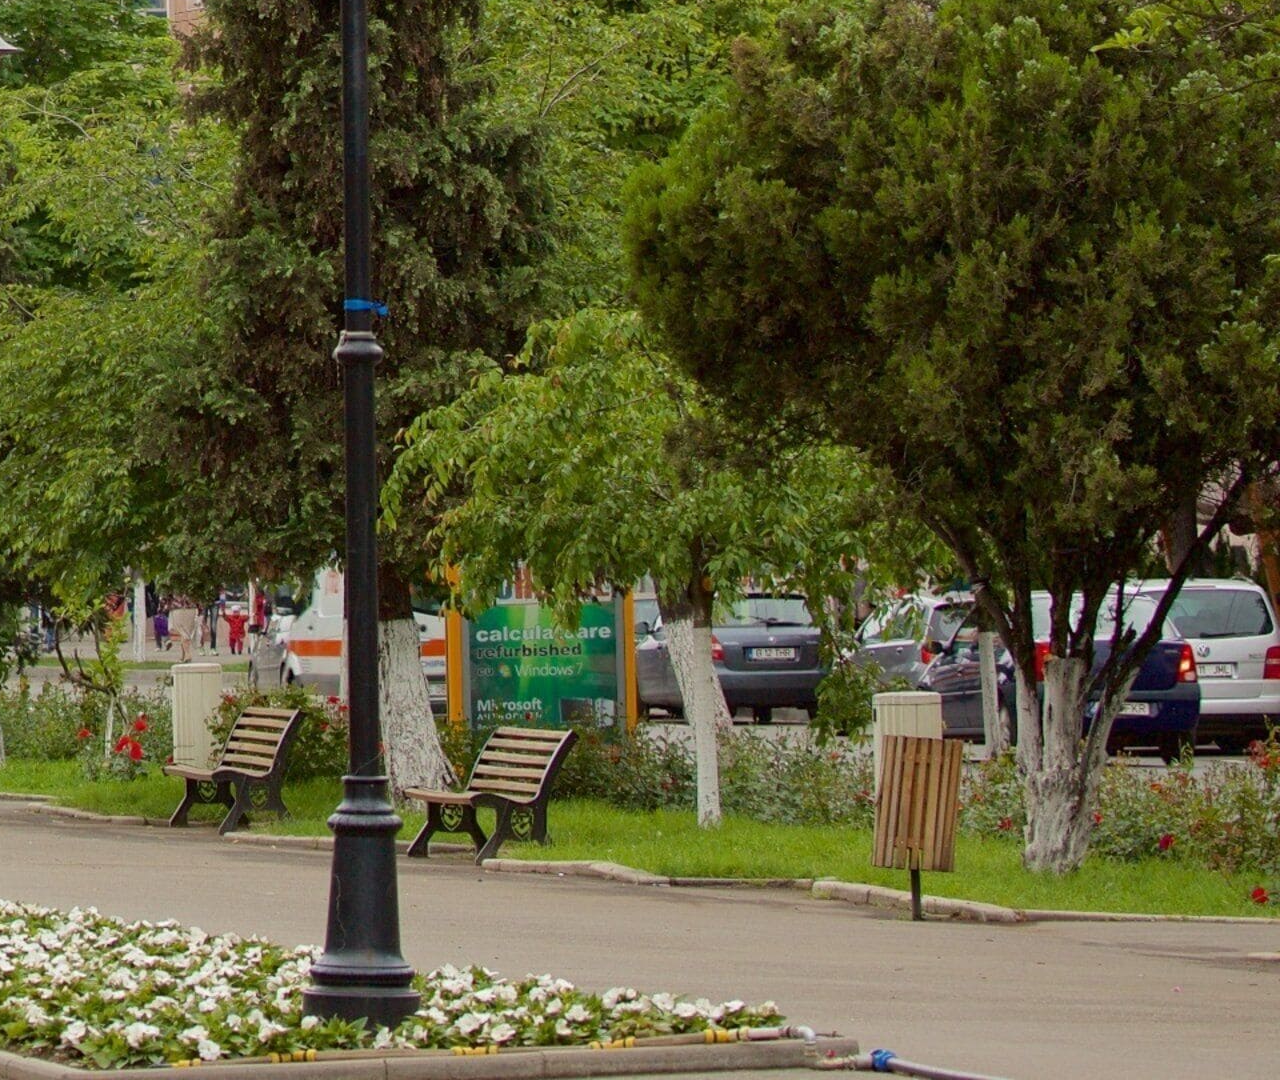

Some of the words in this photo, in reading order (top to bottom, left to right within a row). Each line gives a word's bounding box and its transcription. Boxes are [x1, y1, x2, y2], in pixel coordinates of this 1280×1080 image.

[477, 643, 582, 659] refurbished
[514, 663, 574, 677] Windows
[576, 663, 584, 674] 7
[477, 697, 543, 711] Mirosoft
